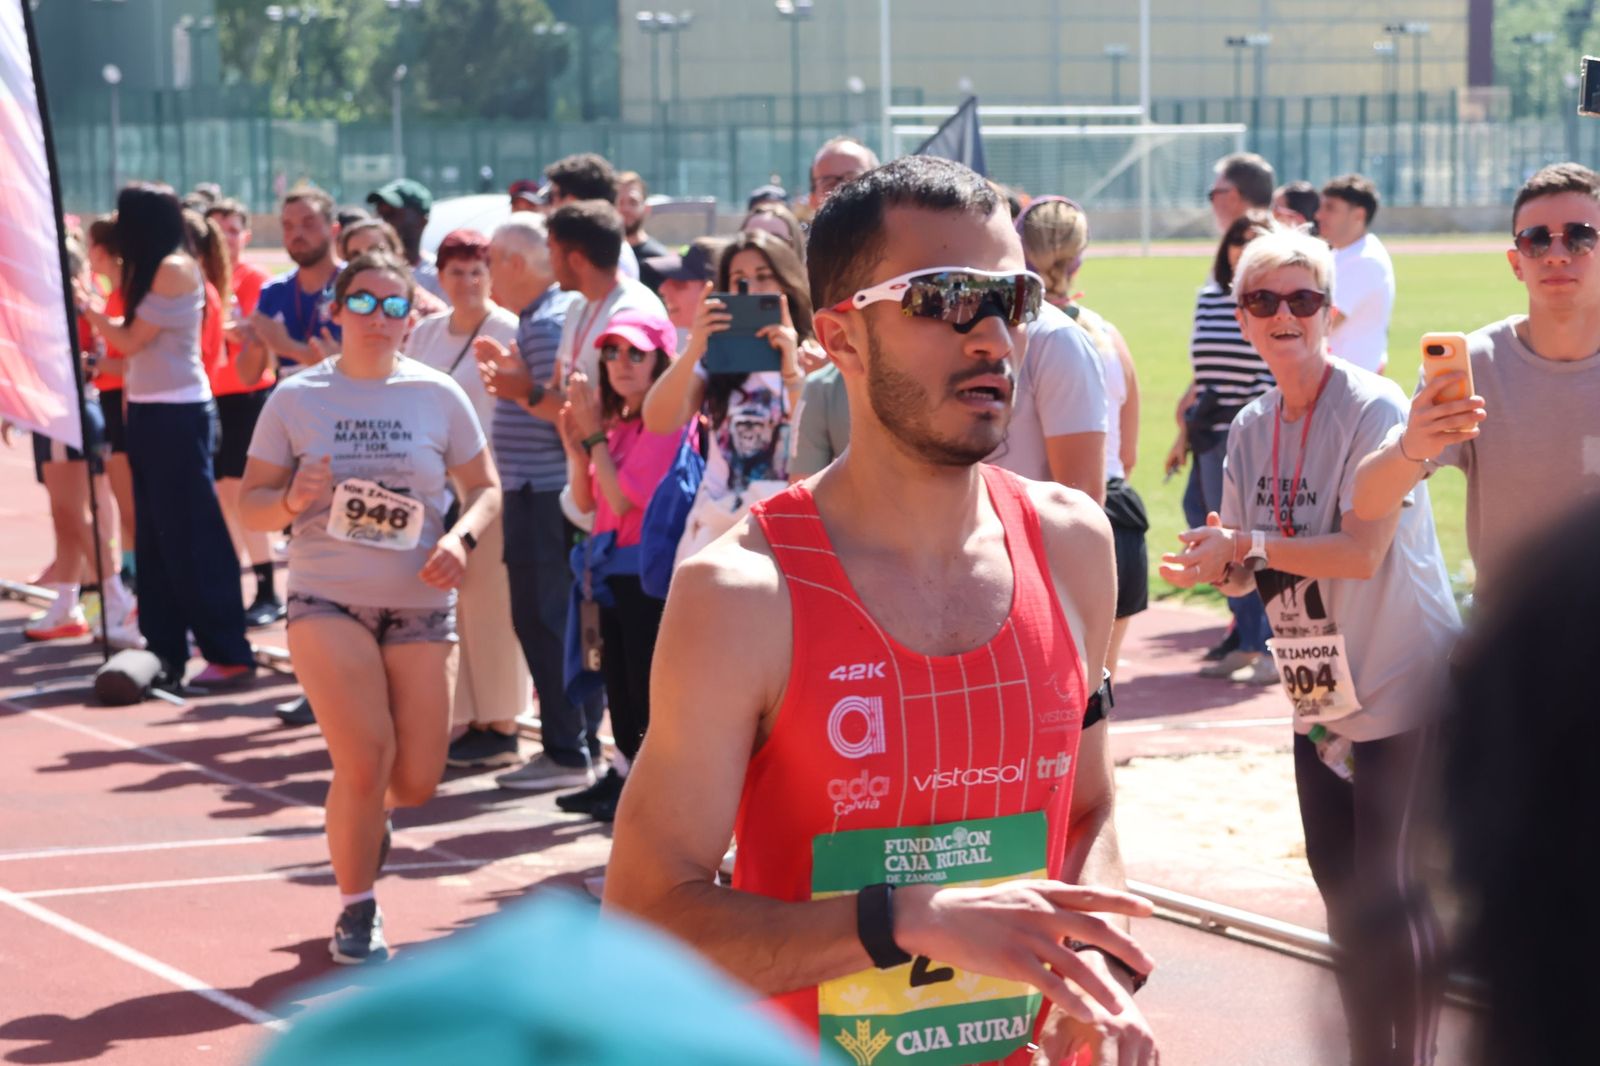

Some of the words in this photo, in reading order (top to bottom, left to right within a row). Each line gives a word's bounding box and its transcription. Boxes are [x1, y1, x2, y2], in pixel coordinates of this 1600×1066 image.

[355, 419, 402, 431] MEDIA
[346, 498, 409, 530] 948
[1289, 645, 1339, 660] ZAMORA
[828, 661, 886, 681] 42K
[1283, 663, 1337, 695] 904
[827, 768, 890, 801] ada
[912, 757, 1025, 792] vistasol
[884, 853, 931, 873] CAJA
[935, 847, 992, 870] RURAL
[886, 874, 901, 884] DE
[904, 871, 948, 883] ZAMORA
[895, 1025, 952, 1056] CAJA
